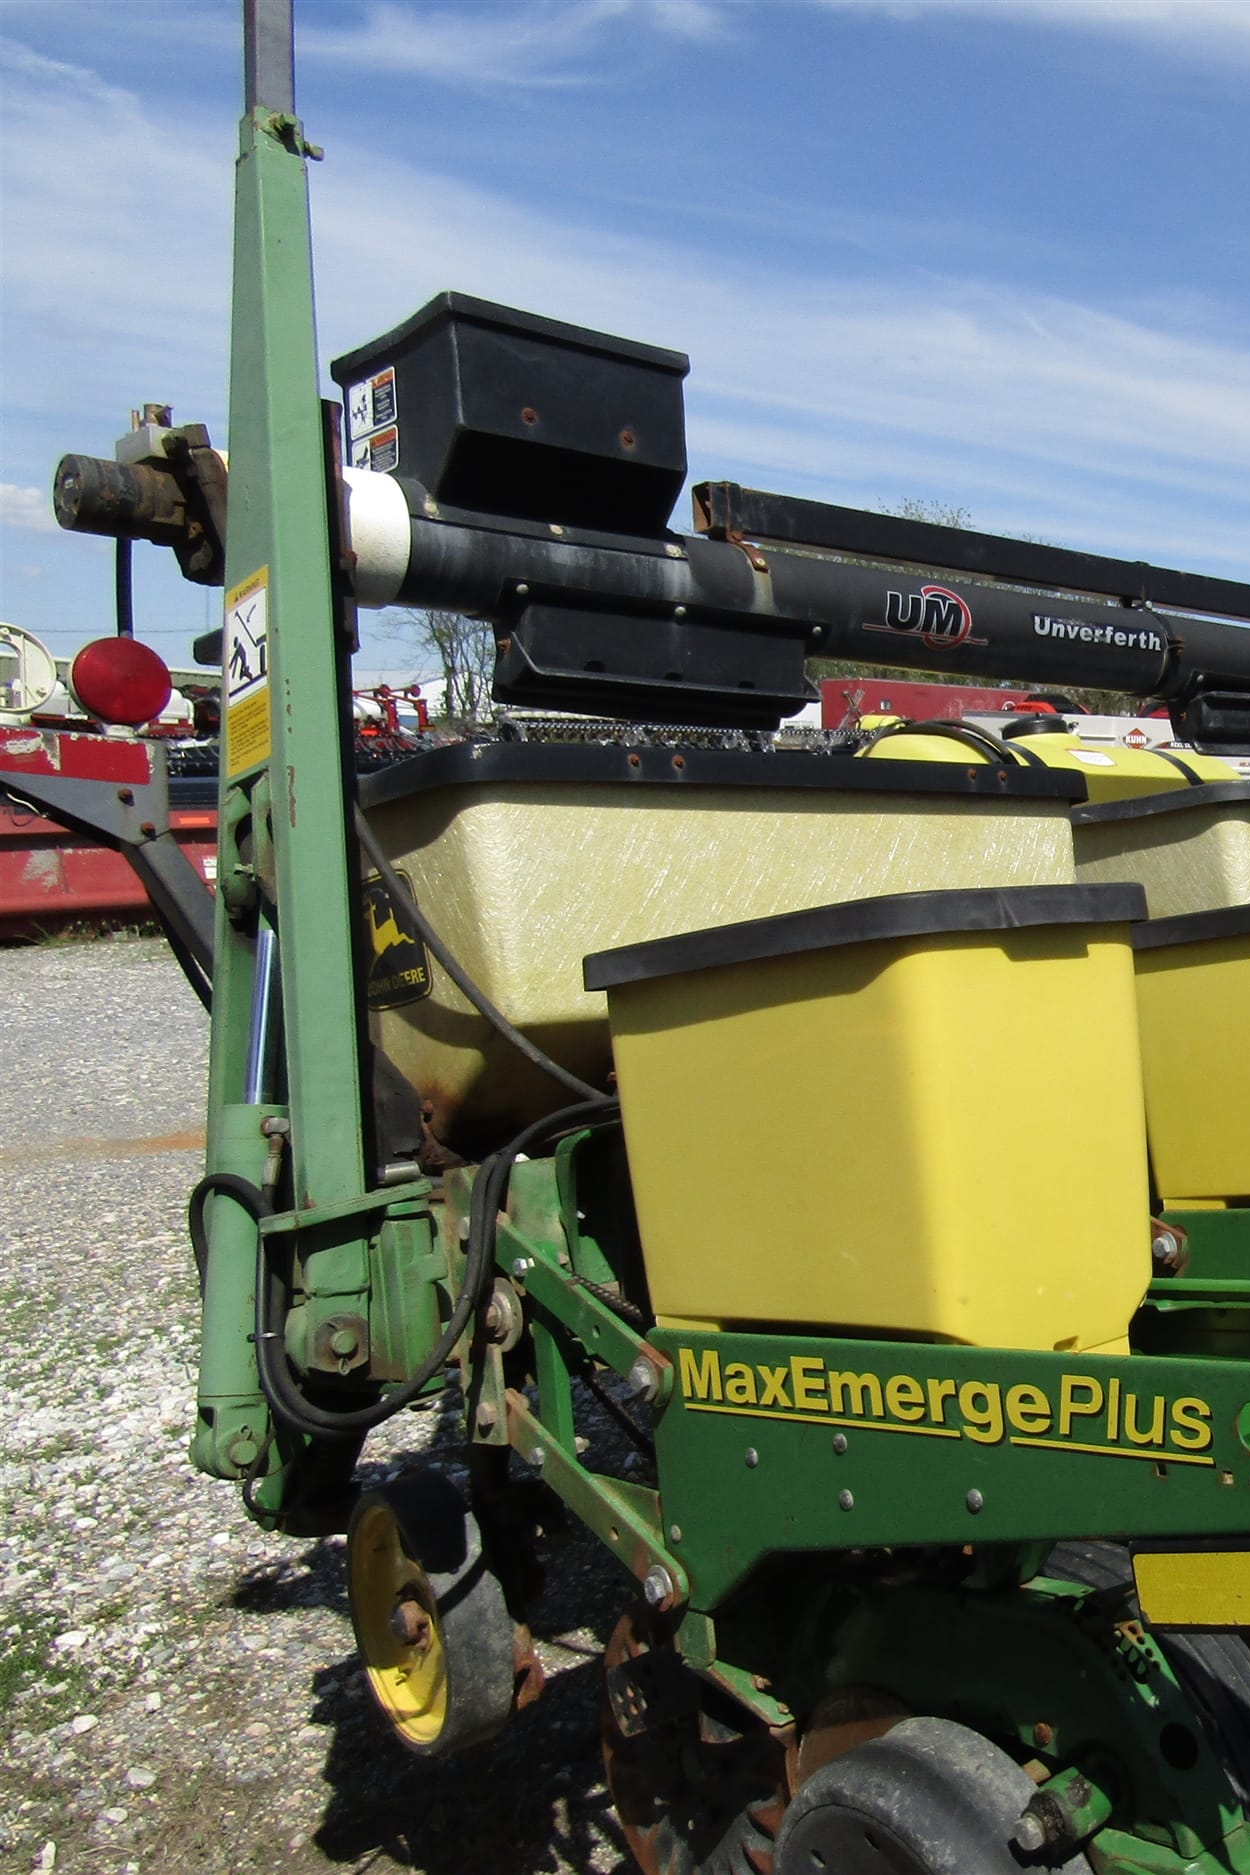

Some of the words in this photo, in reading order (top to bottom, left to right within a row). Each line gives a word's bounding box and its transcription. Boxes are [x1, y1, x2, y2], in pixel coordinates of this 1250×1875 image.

[885, 590, 965, 639] UM
[1033, 614, 1162, 651] Unverferth
[1125, 735, 1147, 744] KUHN
[367, 976, 391, 997] OHN
[391, 966, 427, 990] DEERE
